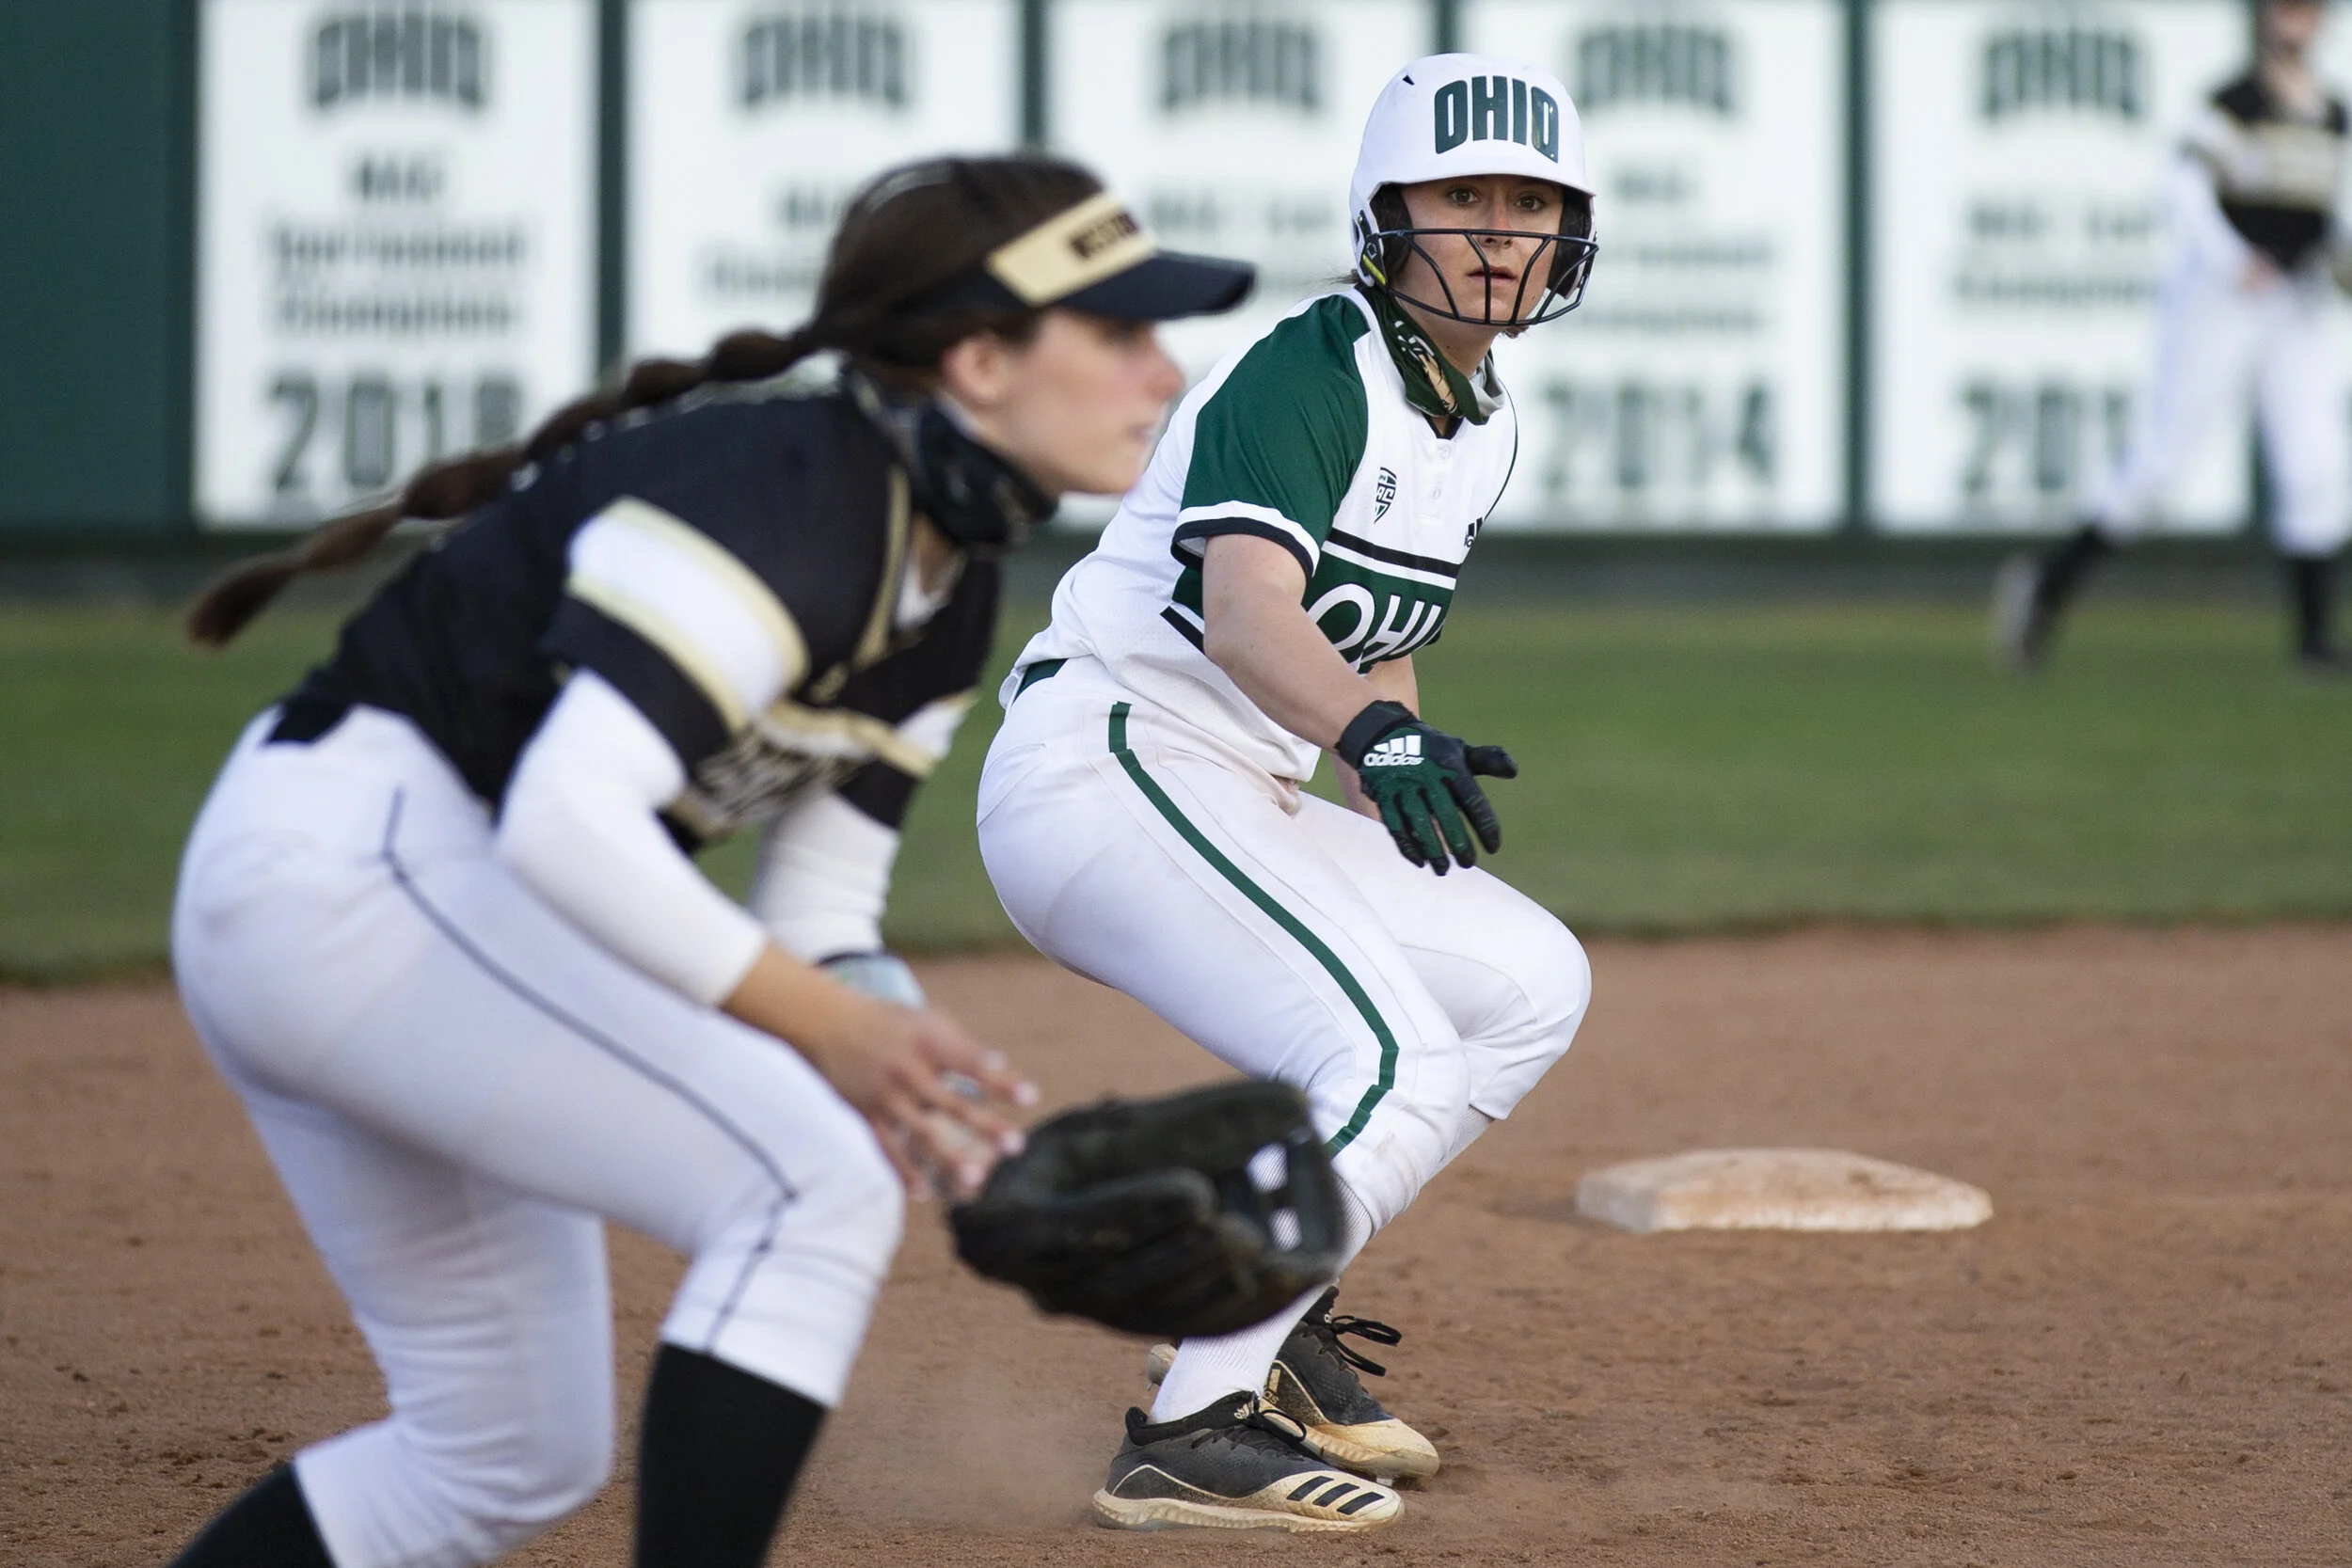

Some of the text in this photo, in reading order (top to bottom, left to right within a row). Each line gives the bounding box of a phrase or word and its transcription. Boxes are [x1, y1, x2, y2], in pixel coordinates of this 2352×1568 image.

[1434, 75, 1559, 164] OHIO
[1306, 582, 1447, 664] OHI
[1363, 752, 1424, 767] adidas
